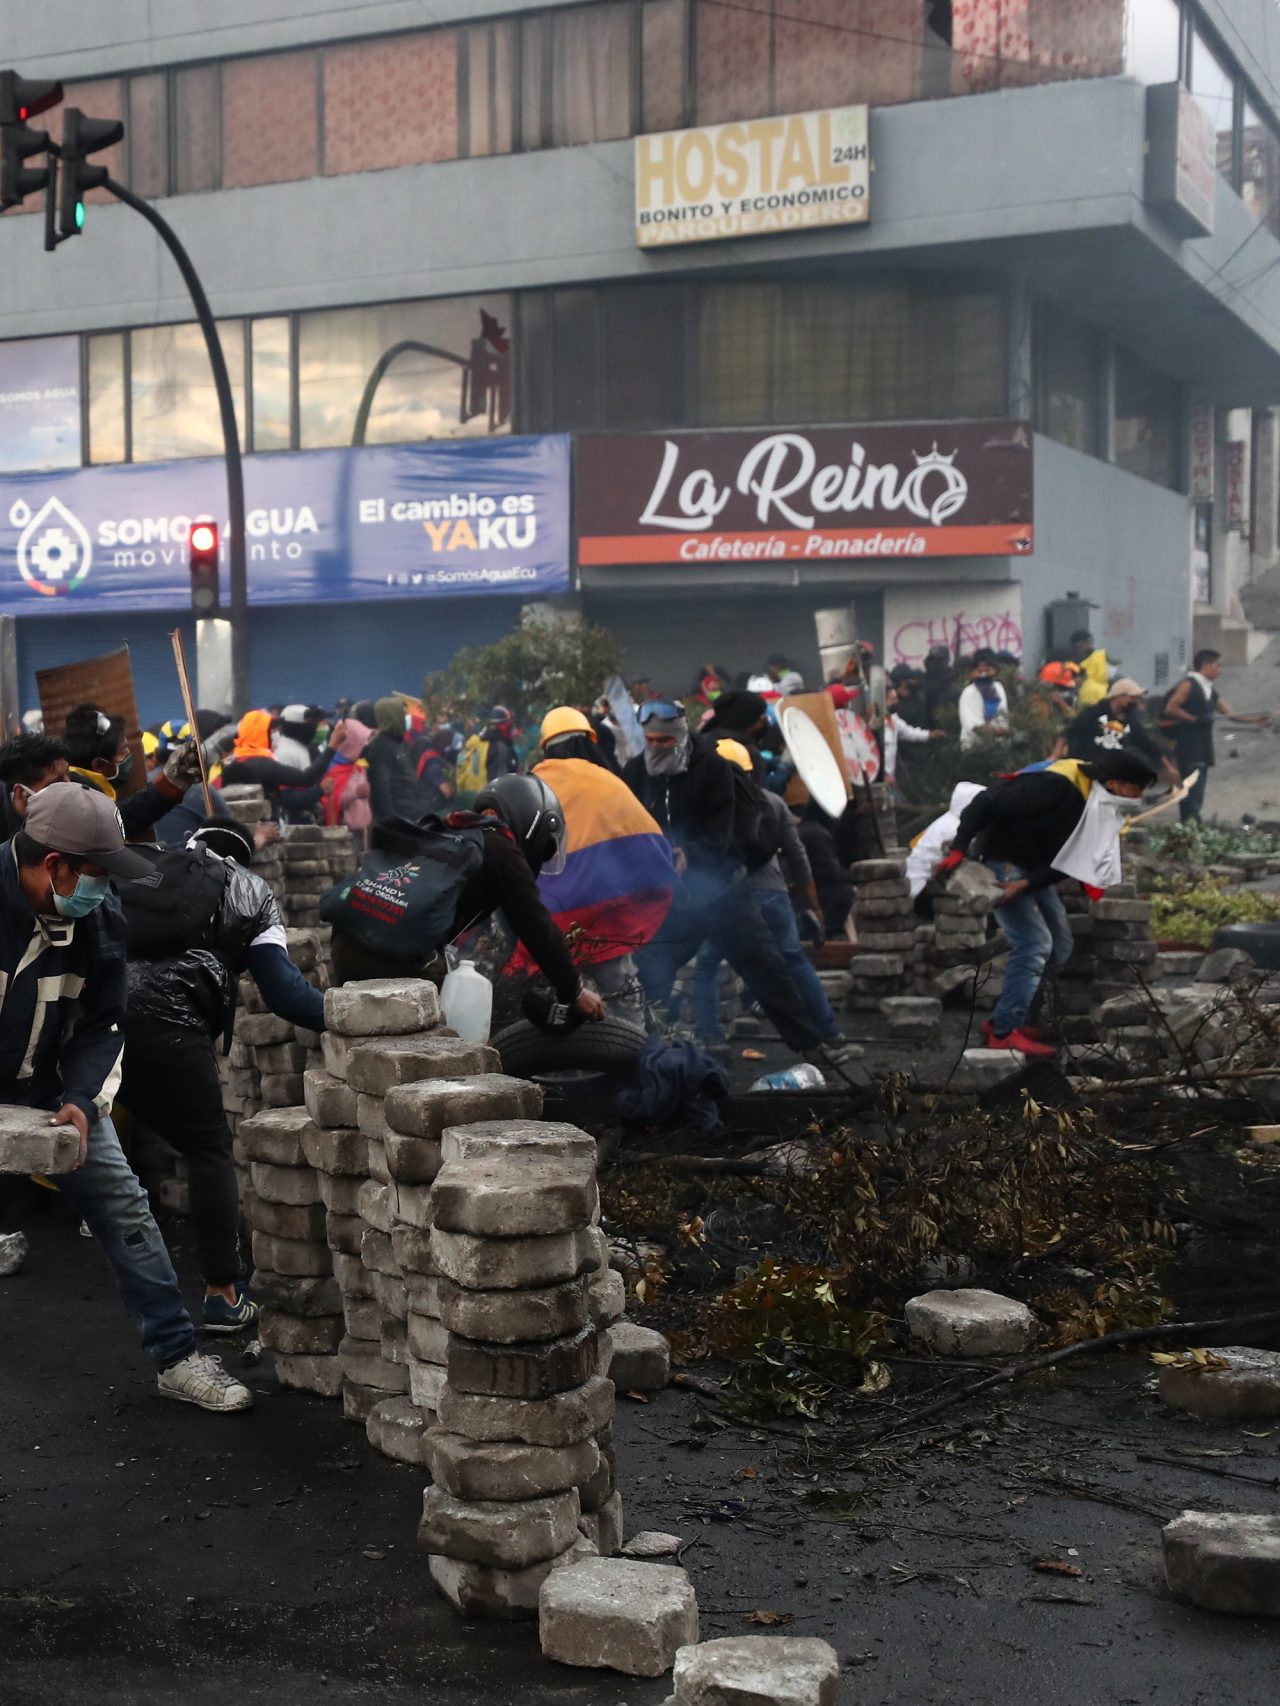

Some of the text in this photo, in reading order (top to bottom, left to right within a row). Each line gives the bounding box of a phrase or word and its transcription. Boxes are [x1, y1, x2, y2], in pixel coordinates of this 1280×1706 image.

[639, 112, 850, 207] HOSTAL
[833, 145, 866, 164] 24H
[640, 205, 713, 225] BONITO
[721, 201, 734, 214] Y
[641, 201, 865, 244] PARQUEADERO
[639, 440, 730, 531] La
[360, 492, 535, 523] El cambio es
[98, 514, 214, 547] SOMO
[422, 514, 537, 552] YAKU
[680, 536, 787, 559] Cafetería
[804, 531, 927, 555] Panadería
[114, 539, 303, 567] moviinto
